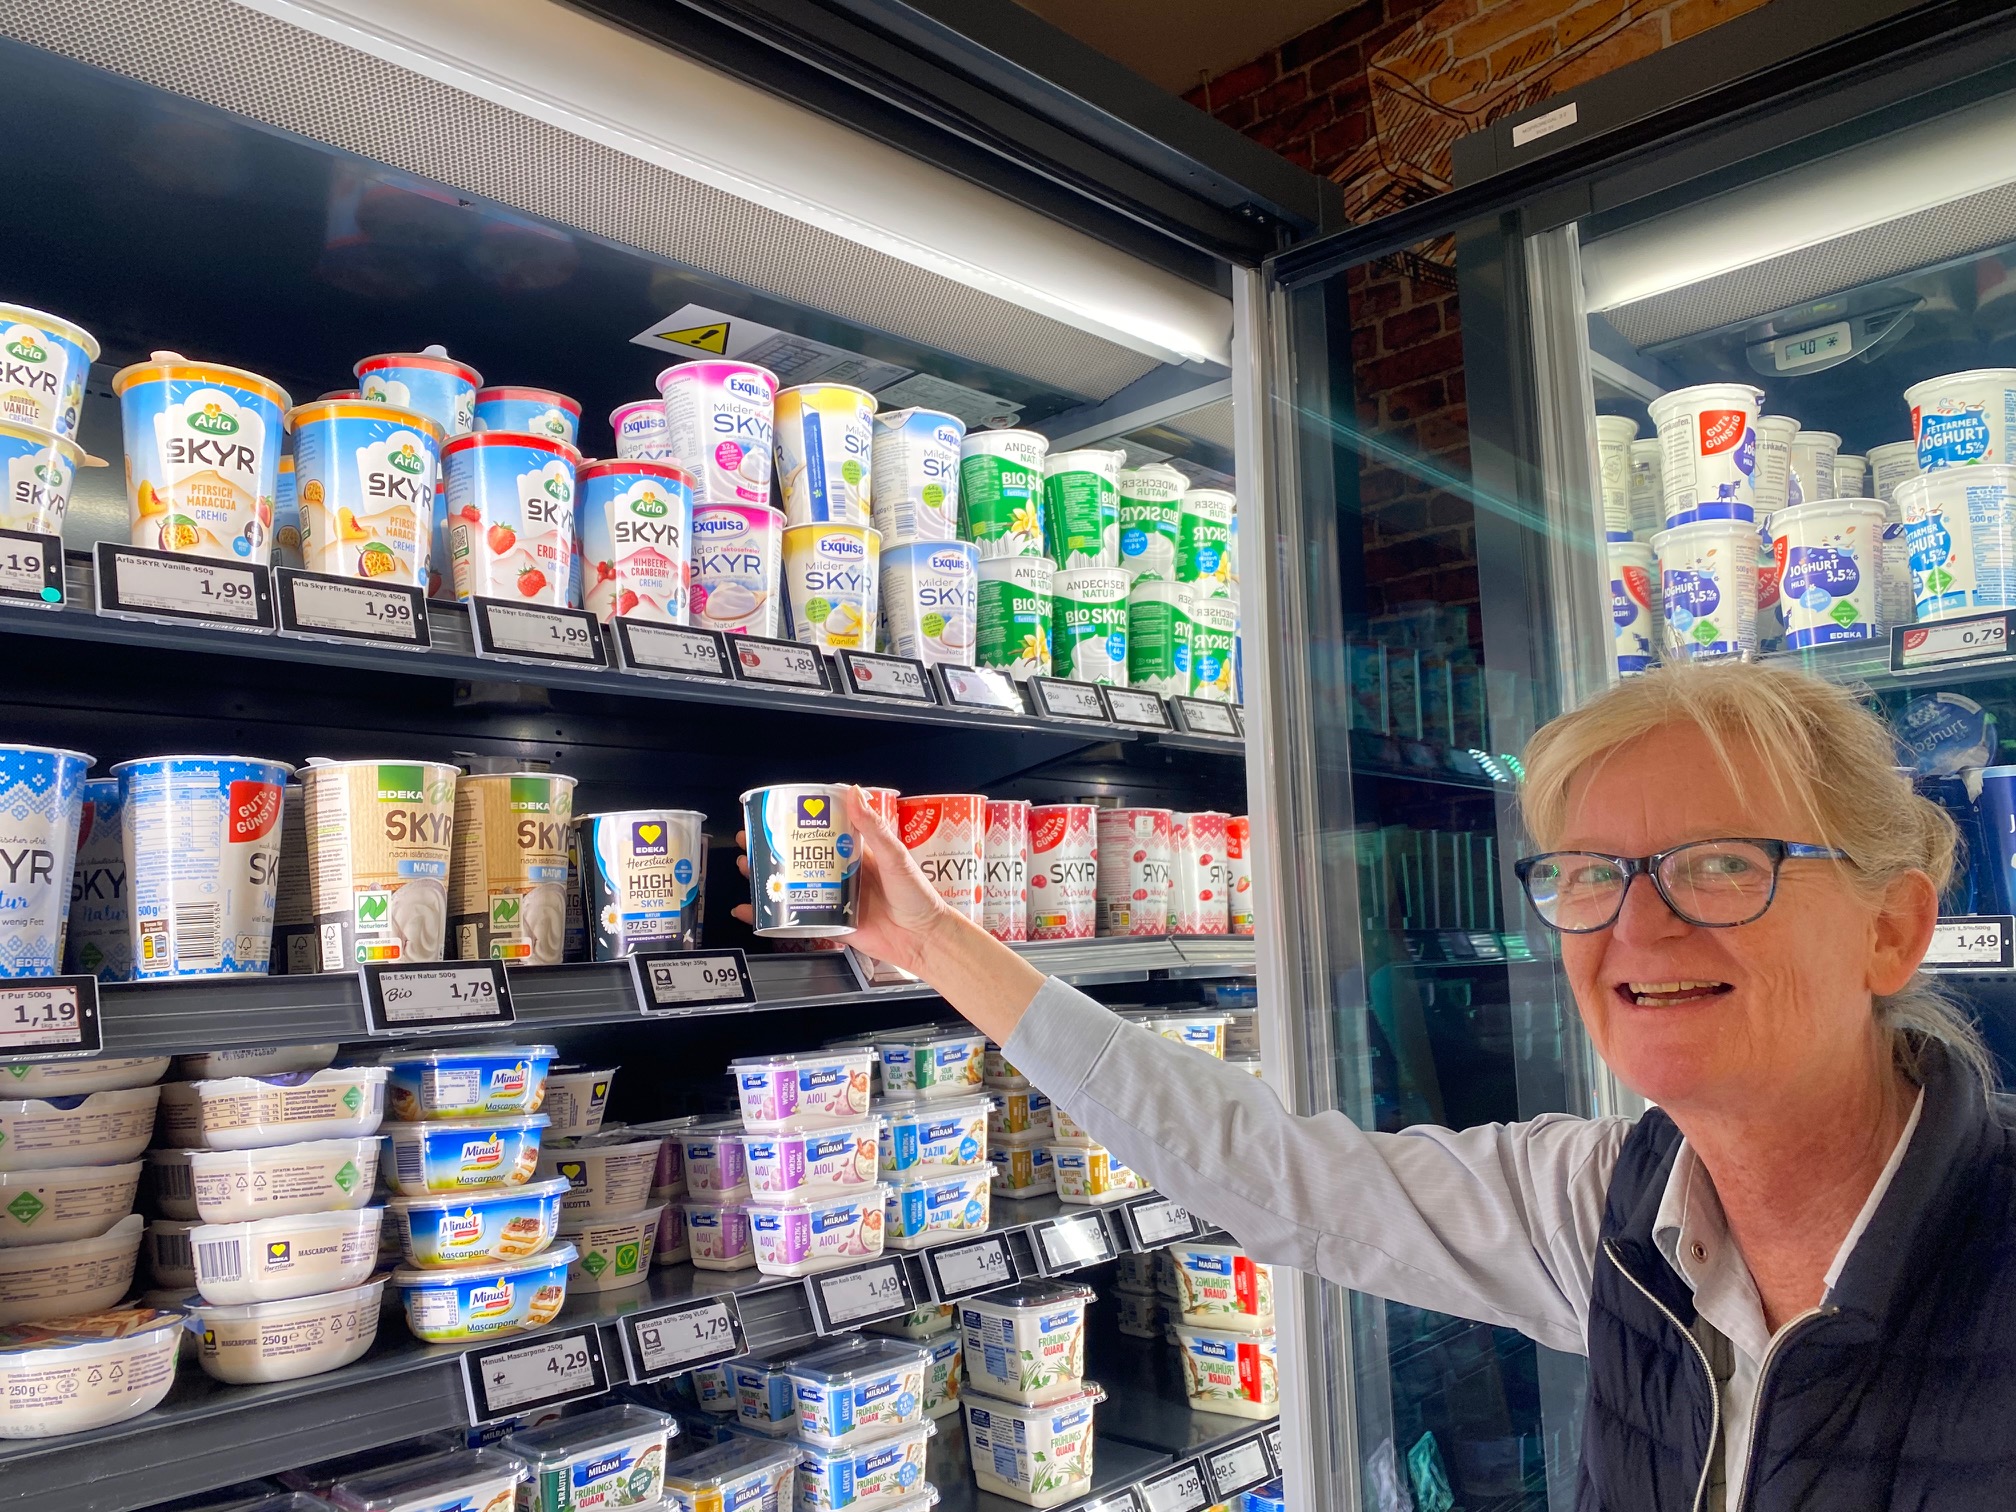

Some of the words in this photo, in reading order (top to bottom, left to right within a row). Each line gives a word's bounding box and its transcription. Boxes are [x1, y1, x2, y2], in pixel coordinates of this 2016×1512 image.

[11, 344, 43, 360] Arla
[730, 378, 770, 399] Exquisa
[3, 402, 40, 419] VANILLE
[714, 403, 753, 415] Milder
[195, 415, 233, 433] Arla
[623, 418, 666, 435] Exquisa
[1705, 414, 1741, 449] GÜNSTIG
[1926, 418, 1979, 436] FETTARMER
[1921, 425, 1986, 452] JOGHURT
[167, 438, 254, 474] SKYR
[1954, 441, 1984, 455] 1,5%
[393, 455, 421, 472] Arla
[191, 483, 233, 500] PFIRSICH
[369, 473, 432, 512] SKYR
[16, 482, 64, 519] SKYR
[187, 495, 237, 512] MARACUJA
[637, 502, 663, 515] Arla
[195, 509, 229, 524] CREMIG
[615, 521, 679, 548] SKYR
[692, 519, 744, 535] Exquisa
[821, 540, 864, 556] Exquisa
[116, 556, 131, 564] Arla
[132, 558, 159, 569] SKYR
[161, 560, 192, 572] Vanille
[192, 565, 214, 577] 450g
[633, 557, 667, 569] HIMBEERE
[691, 554, 761, 578] SKYR
[805, 562, 844, 572] Milder
[1789, 559, 1839, 578] JOGHURT
[631, 567, 670, 579] CRANBERRY
[1826, 567, 1857, 583] 3,5%
[293, 579, 307, 588] Arla
[309, 582, 327, 592] Skyr
[388, 592, 407, 602] 450g
[639, 579, 663, 589] CREMIG
[805, 571, 871, 596] SKYR
[918, 578, 953, 588] Milder
[1066, 580, 1126, 592] ANDECHSER
[200, 579, 253, 606] 1,99
[918, 588, 976, 609] SKYR
[1082, 589, 1115, 599] NATUR
[1689, 589, 1717, 604] 3,5%
[366, 601, 411, 624] 1,99
[550, 625, 588, 645] 1,99
[1829, 631, 1862, 640] EDEKA
[1962, 627, 2005, 644] 0,79
[682, 642, 717, 660] 1,99
[784, 655, 815, 672] 1,89
[892, 670, 919, 686] 2,09
[1076, 694, 1098, 709] 1,69
[1138, 702, 1159, 717] 1,99
[378, 791, 424, 800] EDEKA
[236, 791, 278, 834] GÜNSTIG
[238, 796, 264, 818] GUT
[510, 802, 550, 810] EDEKA
[385, 809, 452, 847] SKYR
[800, 819, 828, 827] EDEKA
[904, 808, 935, 845] GÜNSTIG
[791, 829, 837, 841] Herzstücke
[1036, 816, 1065, 849] GÜNSTIG
[635, 846, 665, 854] EDEKA
[793, 846, 835, 860] HIGH
[413, 862, 439, 874] NATUR
[626, 856, 675, 870] Herzstücke
[793, 861, 835, 870] PROTEIN
[920, 858, 978, 883] SKYR
[542, 867, 563, 878] NATUR
[803, 870, 826, 878] SKYR
[1050, 863, 1096, 884] SKYR
[629, 874, 673, 890] HIGH
[629, 889, 674, 900] PROTEIN
[641, 899, 664, 908] SKYR
[1, 919, 28, 928] wenig
[29, 918, 45, 926] Fett
[359, 921, 388, 930] Naturland
[1956, 934, 1998, 951] 1,49
[417, 972, 437, 980] Natur
[438, 971, 457, 980] 500g
[703, 968, 737, 987] 0,99
[27, 991, 52, 999] 500g
[386, 988, 413, 1002] Bio
[450, 981, 493, 1002] 1,79
[14, 1002, 76, 1027] 1,19
[493, 1070, 525, 1087] MinusL
[811, 1072, 836, 1085] MILRAM
[484, 1100, 527, 1112] Mascarpone
[806, 1092, 827, 1105] AIOLI
[928, 1124, 954, 1139] MILRAM
[464, 1139, 501, 1158] MinusL
[818, 1142, 844, 1157] MILRAM
[923, 1144, 948, 1158] ZAZIKI
[813, 1163, 834, 1176] AIOLI
[456, 1172, 506, 1185] Mascarpone
[562, 1199, 592, 1210] RICOTTA
[936, 1191, 959, 1205] MILRAM
[823, 1213, 849, 1228] MILRAM
[930, 1209, 953, 1224] ZAZIKI
[1165, 1207, 1187, 1224] 1,49
[819, 1234, 840, 1247] AIOLI
[297, 1245, 338, 1258] MASCARPONE
[436, 1247, 490, 1262] Mascarpone
[977, 1251, 1004, 1272] 1,49
[868, 1277, 898, 1298] 1,49
[471, 1286, 511, 1306] MinusL
[466, 1317, 519, 1333] Mascarpone
[636, 1320, 663, 1333] E.Ricotta
[693, 1309, 709, 1318] VLOG
[693, 1316, 729, 1341] 1,79
[262, 1335, 281, 1346] 250
[1038, 1332, 1071, 1350] FRÜHLINGS
[482, 1356, 506, 1367] MinusL
[507, 1348, 546, 1363] Mascarpone
[547, 1342, 564, 1355] 250g
[547, 1350, 588, 1378] 4,29
[9, 1384, 27, 1398] 250
[866, 1384, 891, 1399] MILRAM
[856, 1403, 885, 1418] FRÜHLINGS
[1050, 1431, 1081, 1449] FRÜHLINGS
[588, 1459, 620, 1478] MILRAM
[867, 1455, 892, 1471] MILRAM
[842, 1466, 852, 1493] LEICHT
[856, 1473, 887, 1490] FRÜHLINGS
[1177, 1476, 1200, 1499] 2,99
[574, 1481, 613, 1500] FRÜHLINGS
[735, 1486, 761, 1505] MILRAM
[859, 1483, 881, 1498] QUARK
[580, 1492, 605, 1509] QUARK
